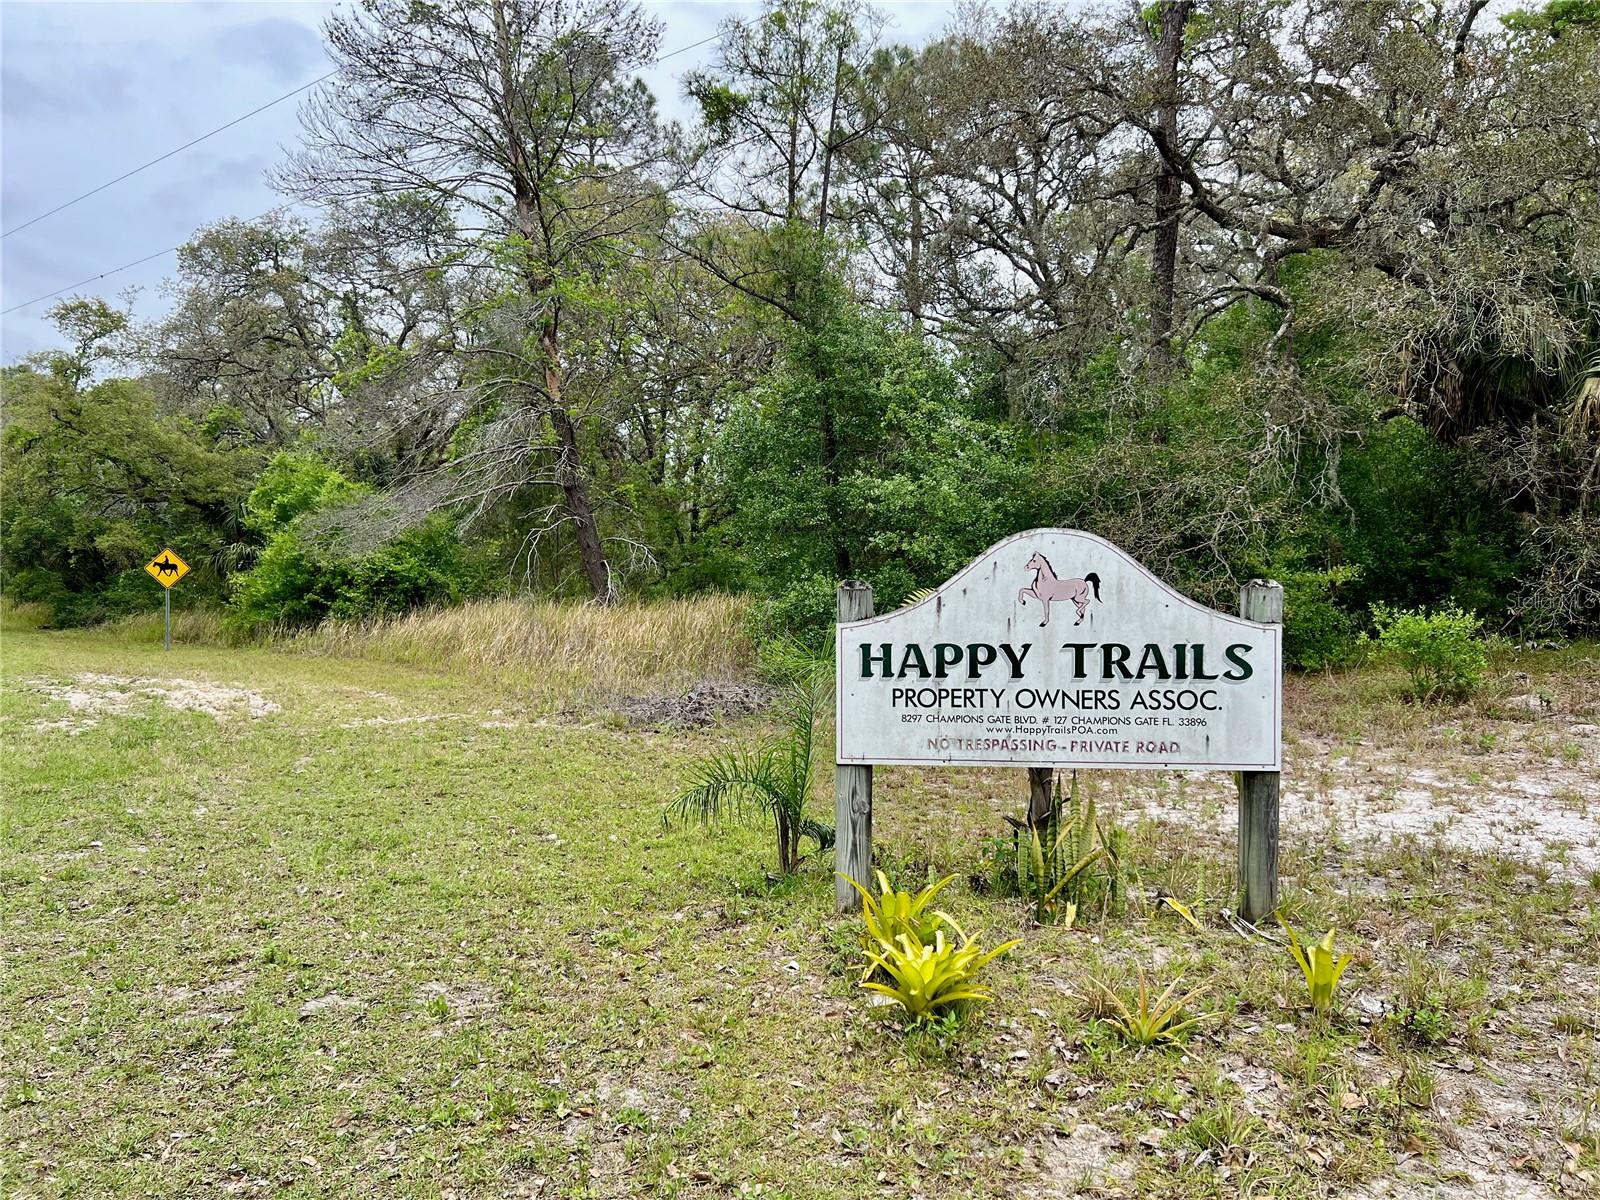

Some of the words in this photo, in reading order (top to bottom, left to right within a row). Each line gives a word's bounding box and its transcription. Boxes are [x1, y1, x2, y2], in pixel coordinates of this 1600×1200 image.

[858, 643, 1032, 681] HAPPY
[1060, 643, 1254, 682] TRAILS
[892, 688, 1006, 708] PROPERTY
[1015, 688, 1121, 710] OWNERS
[1129, 690, 1223, 711] ASSOC.
[901, 714, 922, 723] 8297
[925, 714, 984, 724] CHAMPIONS
[987, 716, 1011, 724] GATE
[1014, 716, 1038, 724] BLVD.
[1042, 716, 1049, 725] #
[1053, 716, 1068, 725] 127
[1071, 716, 1131, 726] CHAMPIONS
[1134, 717, 1159, 726] GATE
[1162, 718, 1175, 726] FL.
[1178, 717, 1208, 727] 33896
[986, 725, 1118, 737] www.HappyTrailsPOA.com
[928, 738, 950, 750] NO
[957, 738, 1057, 751] TRESPASSING
[1070, 740, 1130, 753] PRIVATE
[1135, 741, 1181, 754] ROAD
